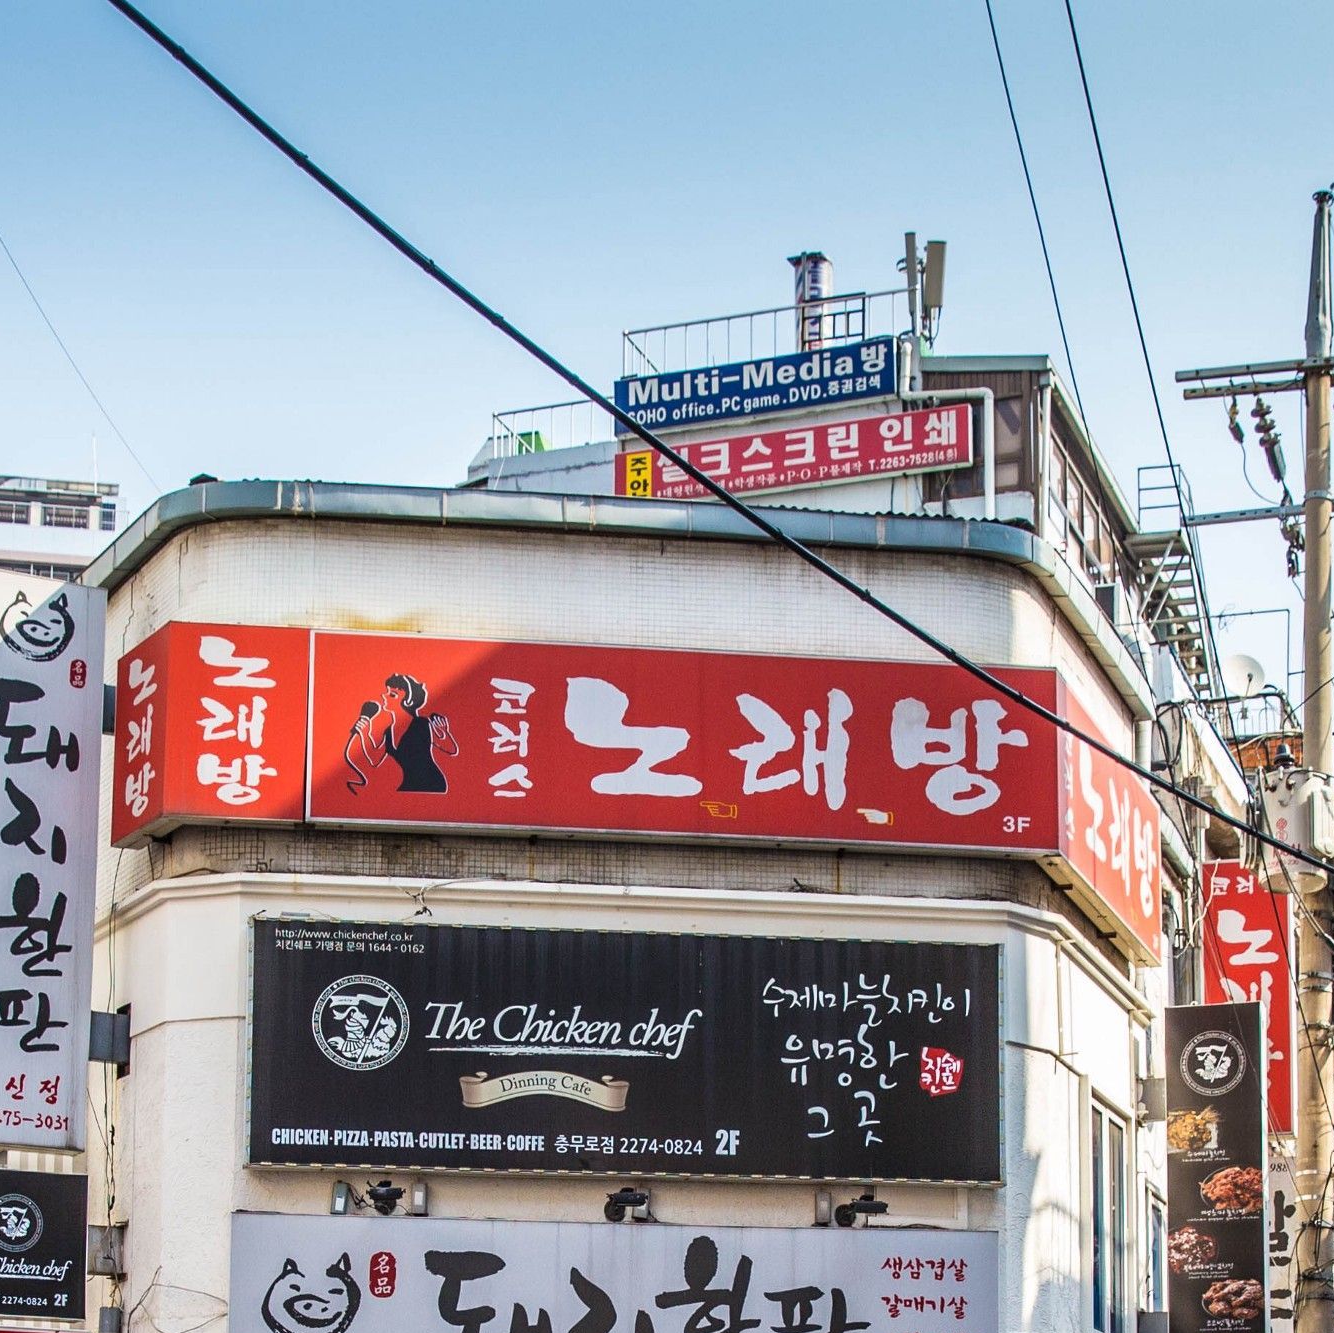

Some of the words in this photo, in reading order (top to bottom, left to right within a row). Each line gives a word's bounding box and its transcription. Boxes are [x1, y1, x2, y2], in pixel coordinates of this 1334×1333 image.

[627, 351, 855, 407] Multi-Media
[859, 344, 888, 378] 방
[657, 418, 860, 484] 실크스크린
[878, 410, 958, 454] 인쇄
[123, 657, 157, 818] 노래방
[195, 634, 277, 806] 노래방
[487, 676, 535, 799] 코러스
[563, 675, 1030, 816] 노래방
[1002, 816, 1031, 834] 3F
[1078, 746, 1154, 919] 노래방
[275, 927, 414, 943] http://www.chickenchef.co.kr
[275, 938, 313, 953] 치킨쉐프
[315, 940, 344, 954] 가맹점
[346, 941, 365, 954] 문의
[368, 942, 393, 954] 1644
[400, 943, 425, 955] 0162
[424, 1000, 486, 1042] The
[493, 1002, 621, 1045] Chicken
[628, 1006, 703, 1060] chef
[780, 1024, 909, 1090] 유명한
[499, 1073, 557, 1094] Dinning
[559, 1074, 594, 1097] Cafe
[553, 1133, 615, 1156] 충무로점
[619, 1137, 704, 1157] 2274-0824
[714, 1129, 741, 1157] 2F
[42, 1258, 73, 1282] chef
[371, 1252, 394, 1297] 名品
[880, 1255, 969, 1282] 생삼겹살
[2, 1294, 48, 1307] 2274-0824
[53, 1293, 68, 1307] 2F
[880, 1293, 969, 1319] 갈매기살
